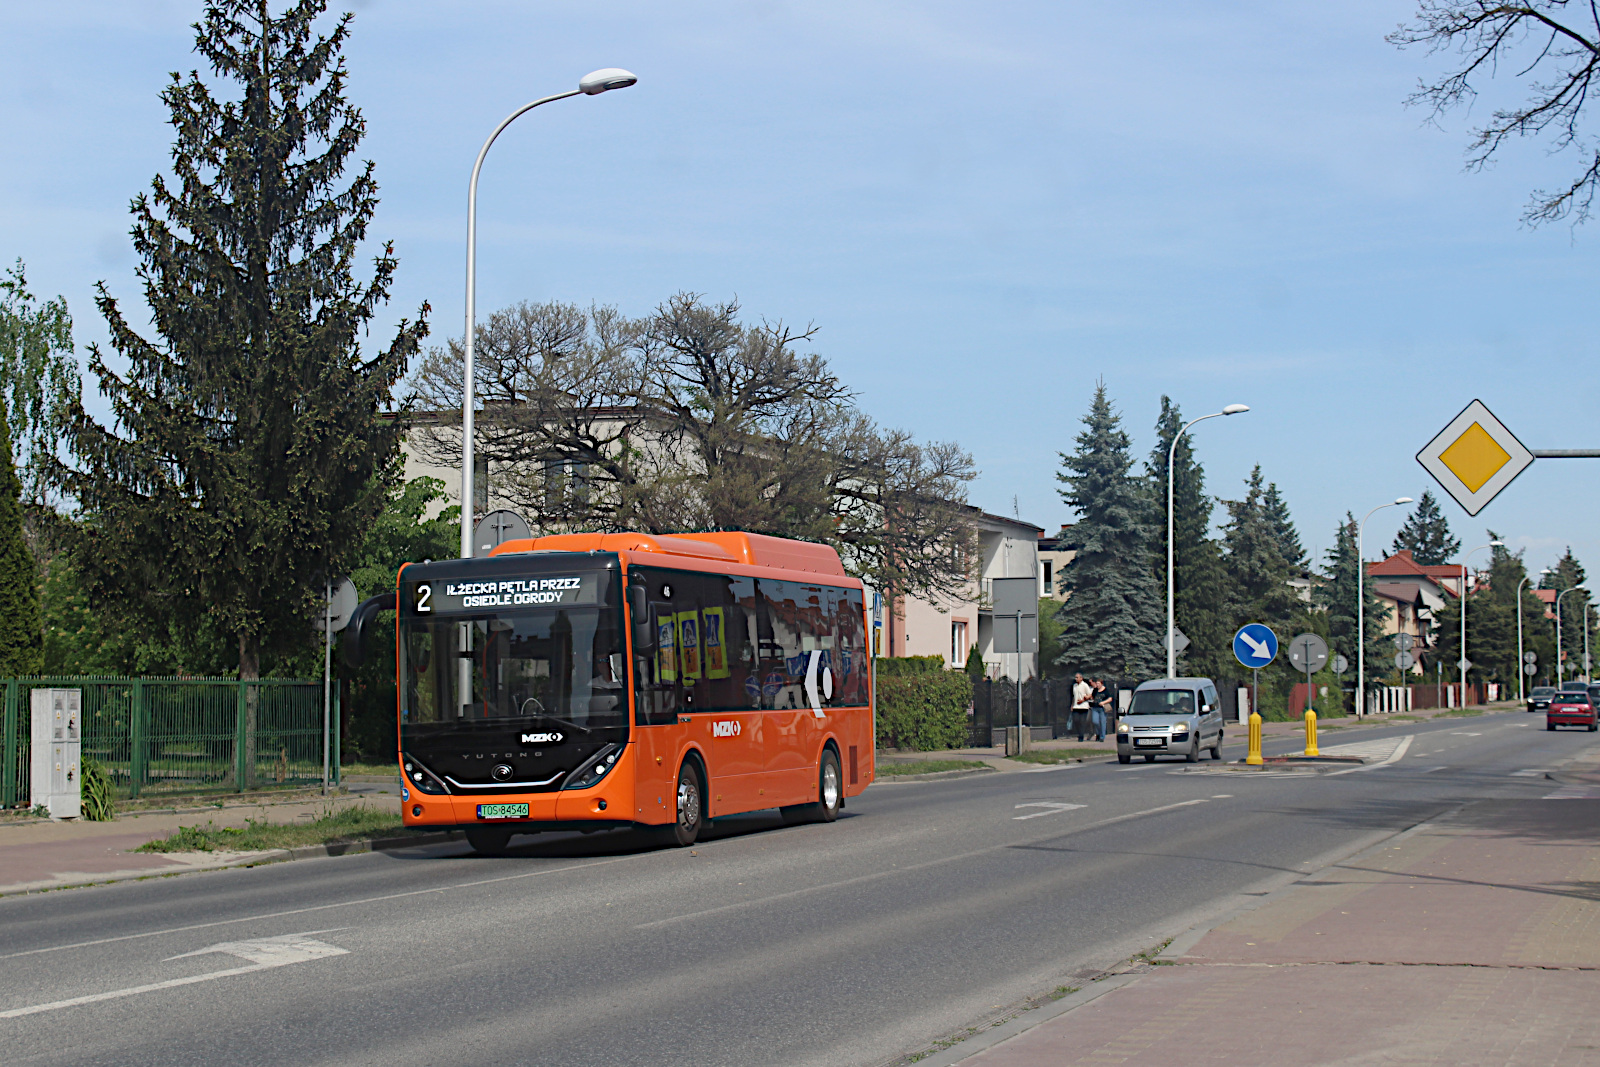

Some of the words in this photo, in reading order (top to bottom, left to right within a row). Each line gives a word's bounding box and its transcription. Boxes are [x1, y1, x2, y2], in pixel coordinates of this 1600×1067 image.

[447, 583, 497, 595] IŁŻECKA
[499, 580, 538, 594] PĘTLA
[540, 578, 580, 590] PRZEZ
[417, 585, 432, 612] 2
[463, 594, 512, 607] OSIEDLE
[513, 591, 563, 604] OGRODY
[462, 751, 543, 760] YUTONG
[482, 805, 498, 815] TOS
[501, 804, 527, 815] 84546
